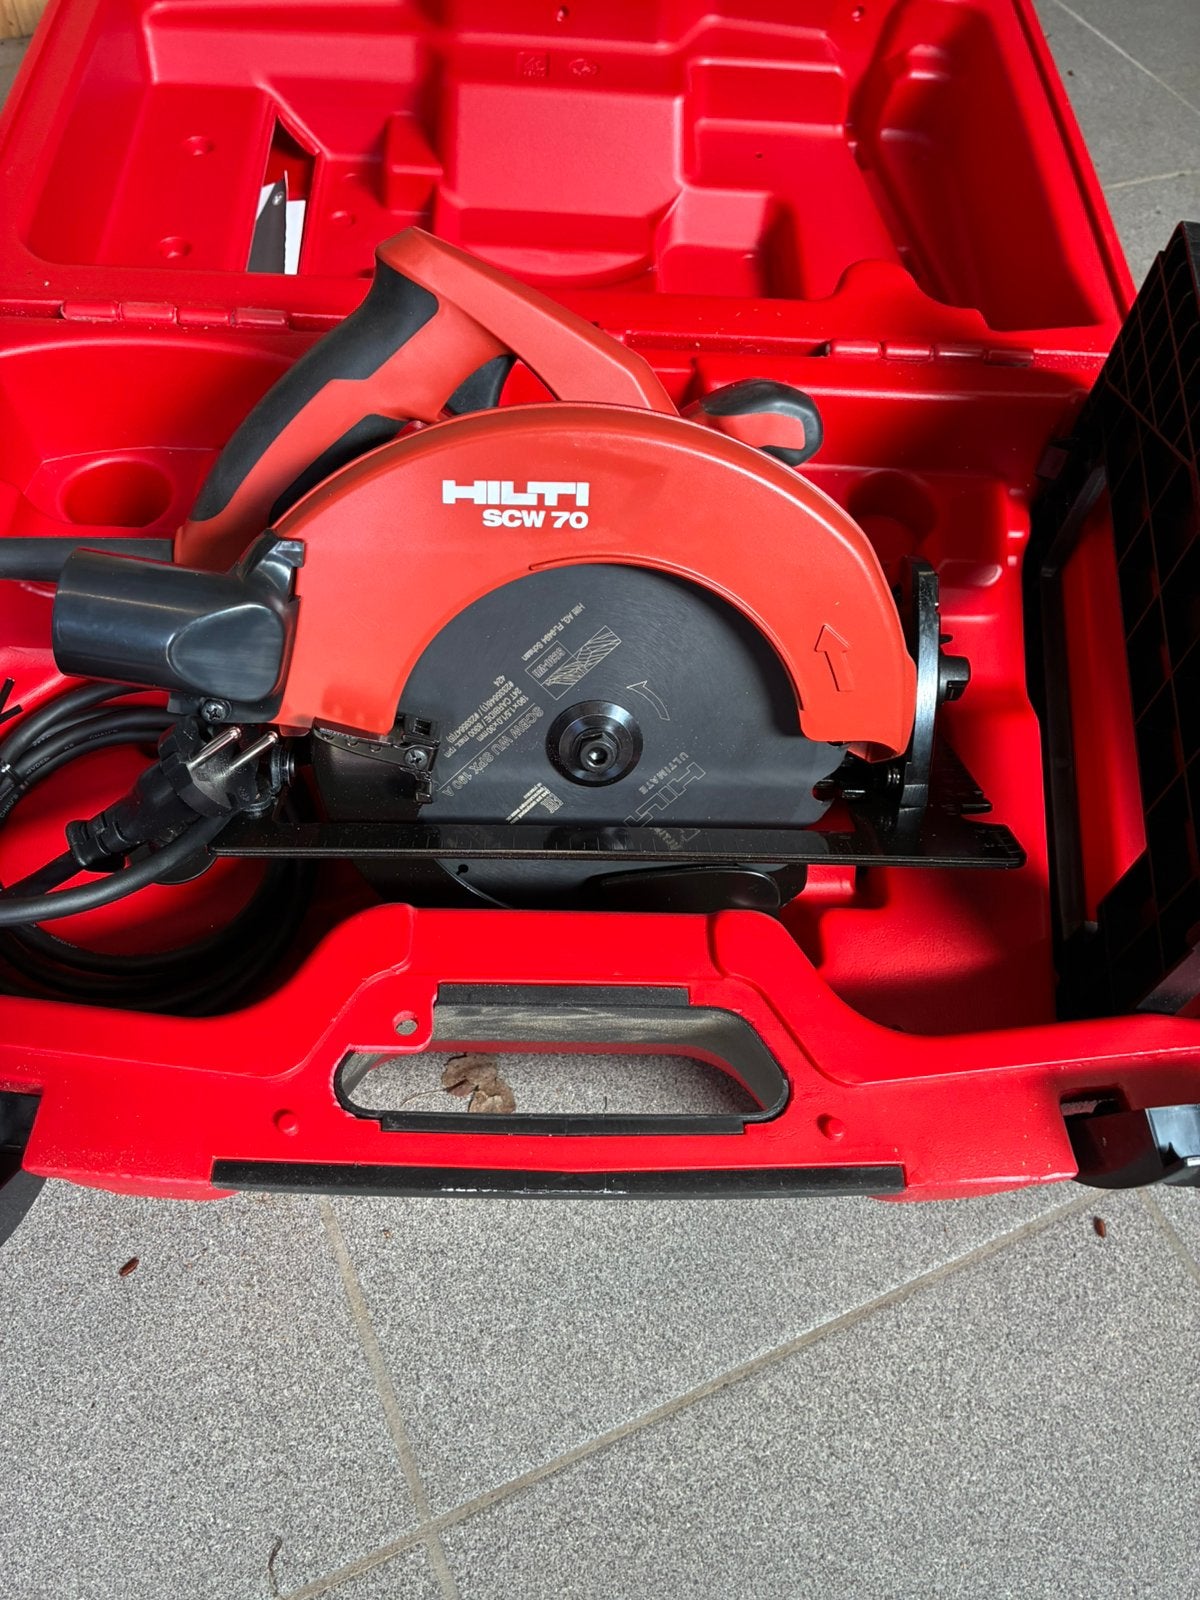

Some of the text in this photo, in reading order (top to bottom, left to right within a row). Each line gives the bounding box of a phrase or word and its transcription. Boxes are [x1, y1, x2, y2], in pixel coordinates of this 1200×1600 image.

[442, 480, 589, 506] HILTI
[482, 509, 589, 529] SCW 70
[492, 674, 506, 686] 424
[483, 697, 511, 723] CARBIDE
[638, 751, 689, 794] ULTIMATE
[623, 761, 706, 828] HILT
